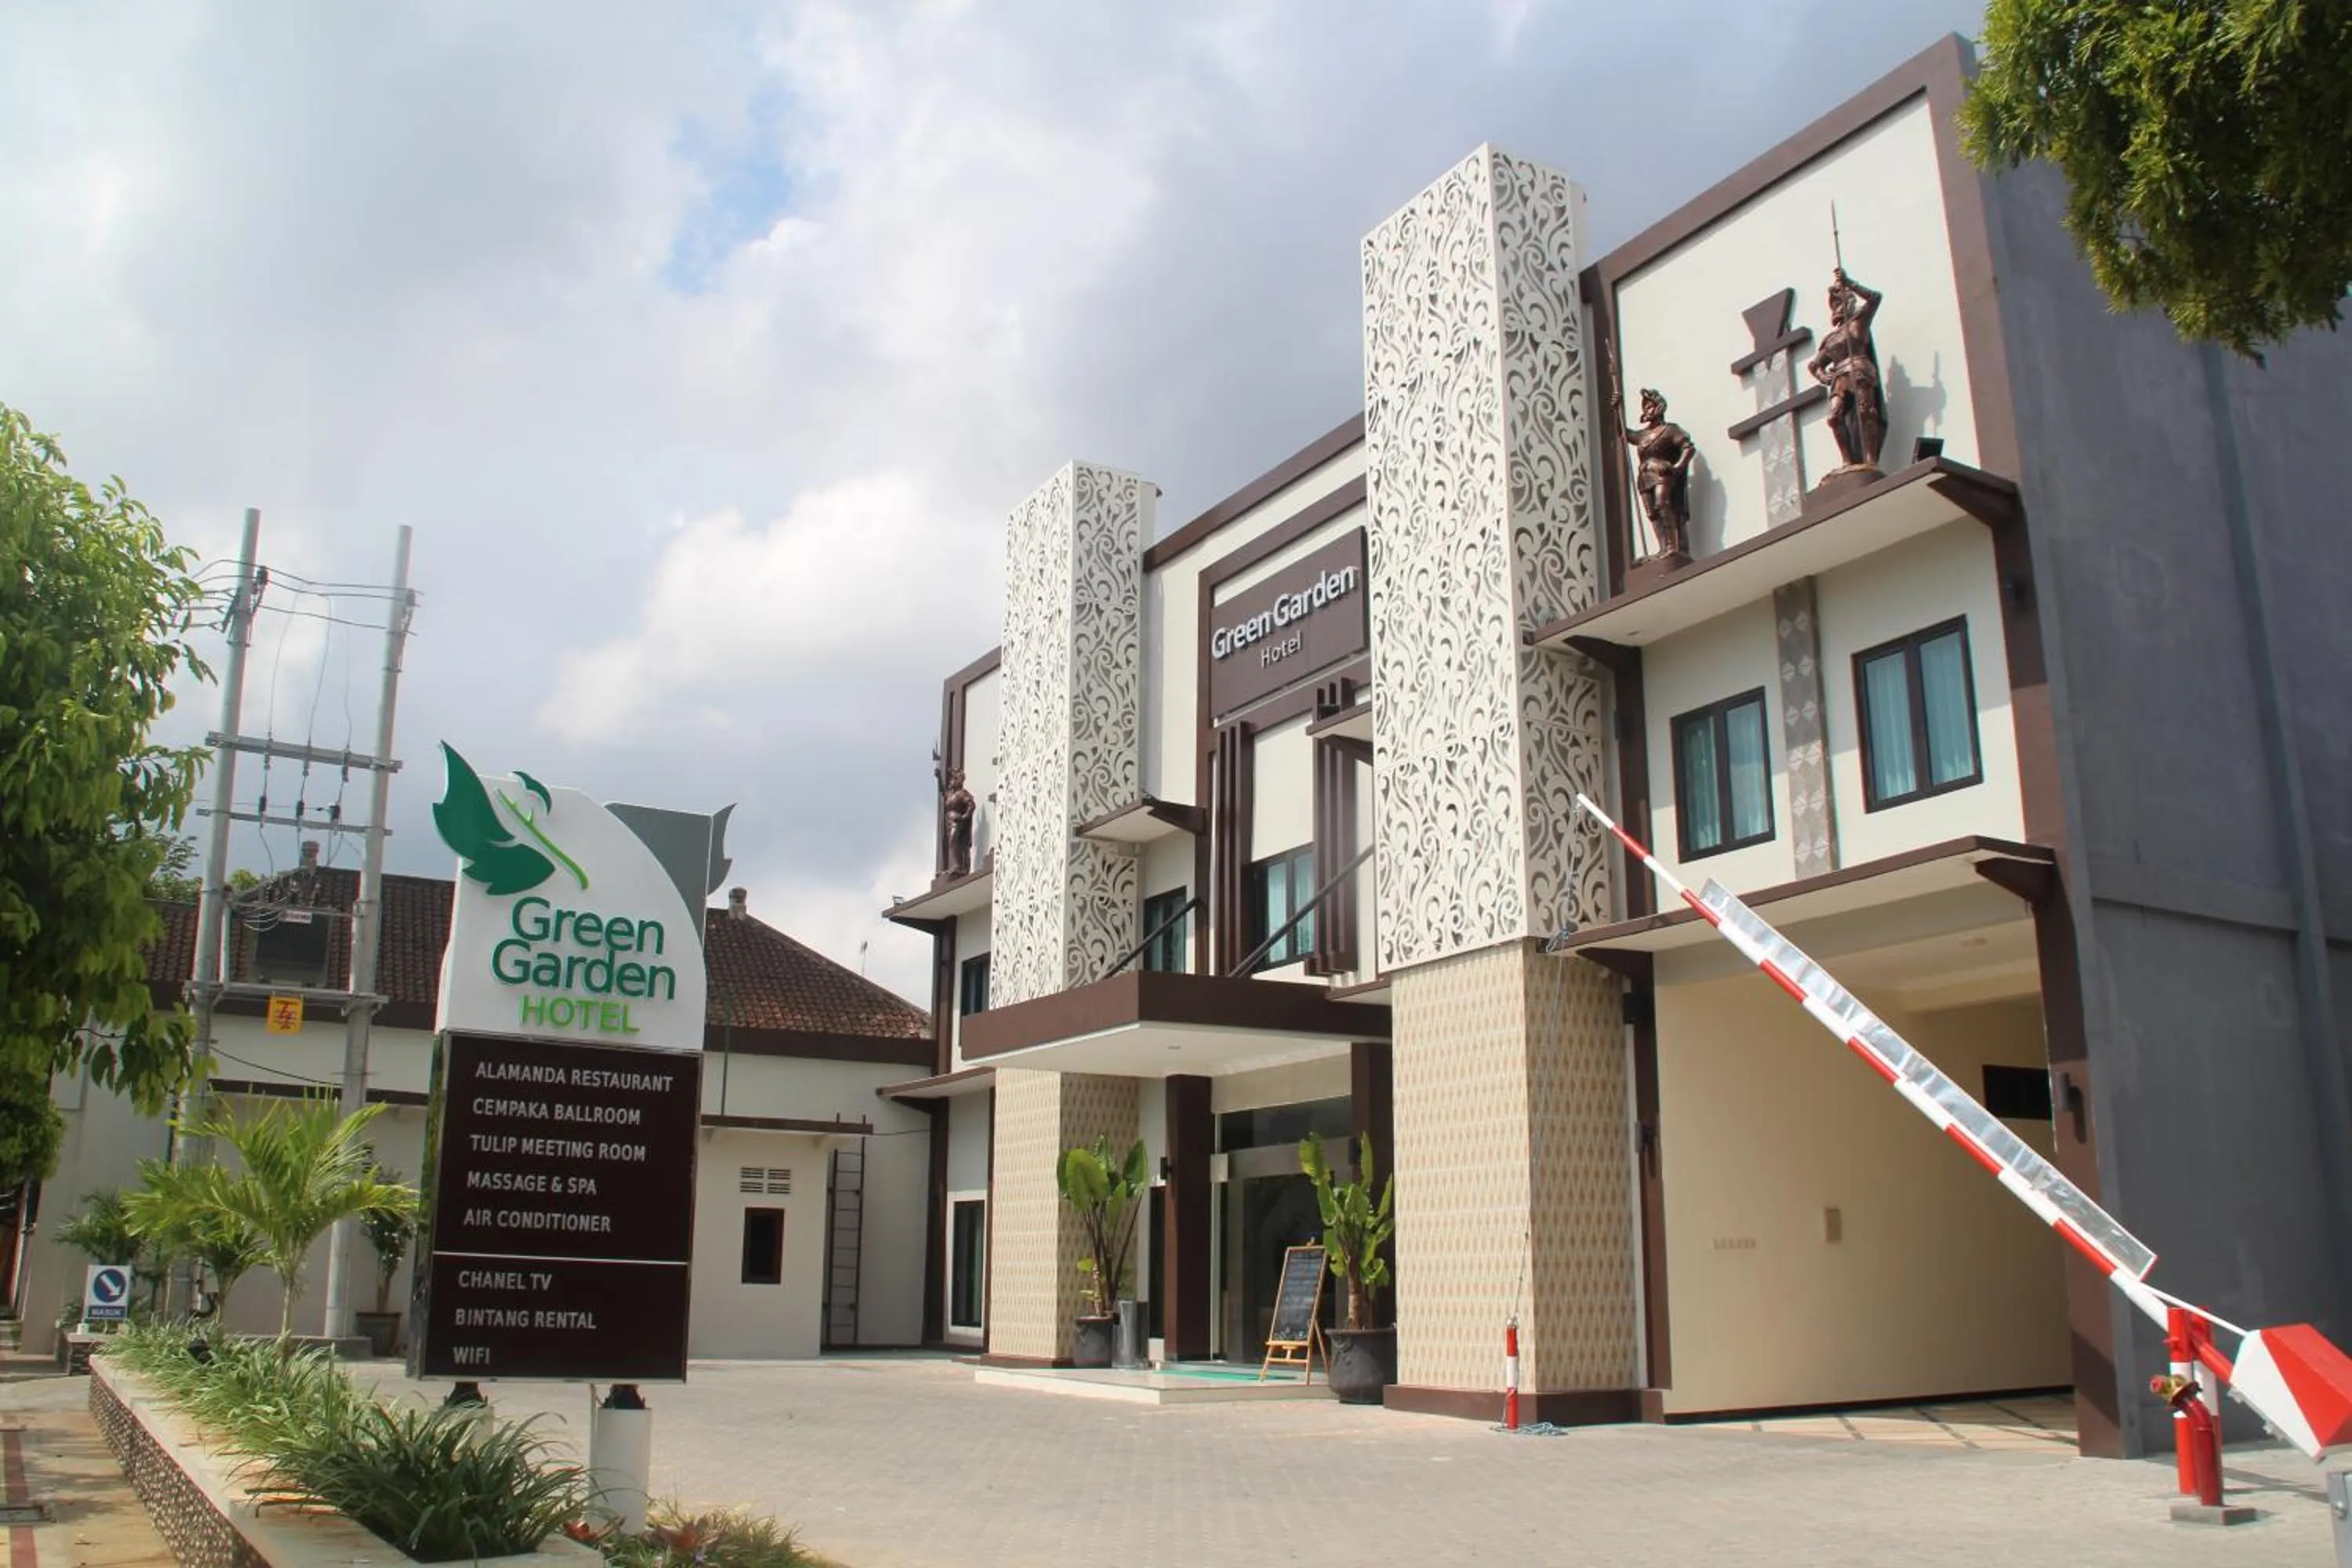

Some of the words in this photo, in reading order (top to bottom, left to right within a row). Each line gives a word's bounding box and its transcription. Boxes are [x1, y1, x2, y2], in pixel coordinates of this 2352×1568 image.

[1212, 611, 1271, 659] Green
[1273, 565, 1356, 626] Garden
[1261, 630, 1301, 667] Hotel
[512, 896, 664, 954] Green
[492, 938, 676, 1000] Garden
[521, 995, 640, 1033] HOTEL
[476, 1062, 566, 1083] ALAMANDA
[571, 1069, 673, 1092] RESTAURANT
[473, 1097, 549, 1119] CEMPAKA
[554, 1103, 641, 1125] BALLROOM
[470, 1134, 517, 1152] TULIP
[521, 1138, 593, 1158] MEETING
[599, 1142, 646, 1161] ROOM
[467, 1171, 546, 1192] MASSAGE
[551, 1176, 562, 1192] &
[568, 1177, 597, 1195] SPA
[463, 1209, 492, 1226] AIR
[497, 1210, 611, 1232] CONDITIONER
[459, 1271, 525, 1290] CHANEL
[531, 1273, 552, 1290] TV
[456, 1308, 528, 1327] BINTANG
[535, 1311, 597, 1329] RENTAL
[453, 1347, 490, 1364] WIFI
